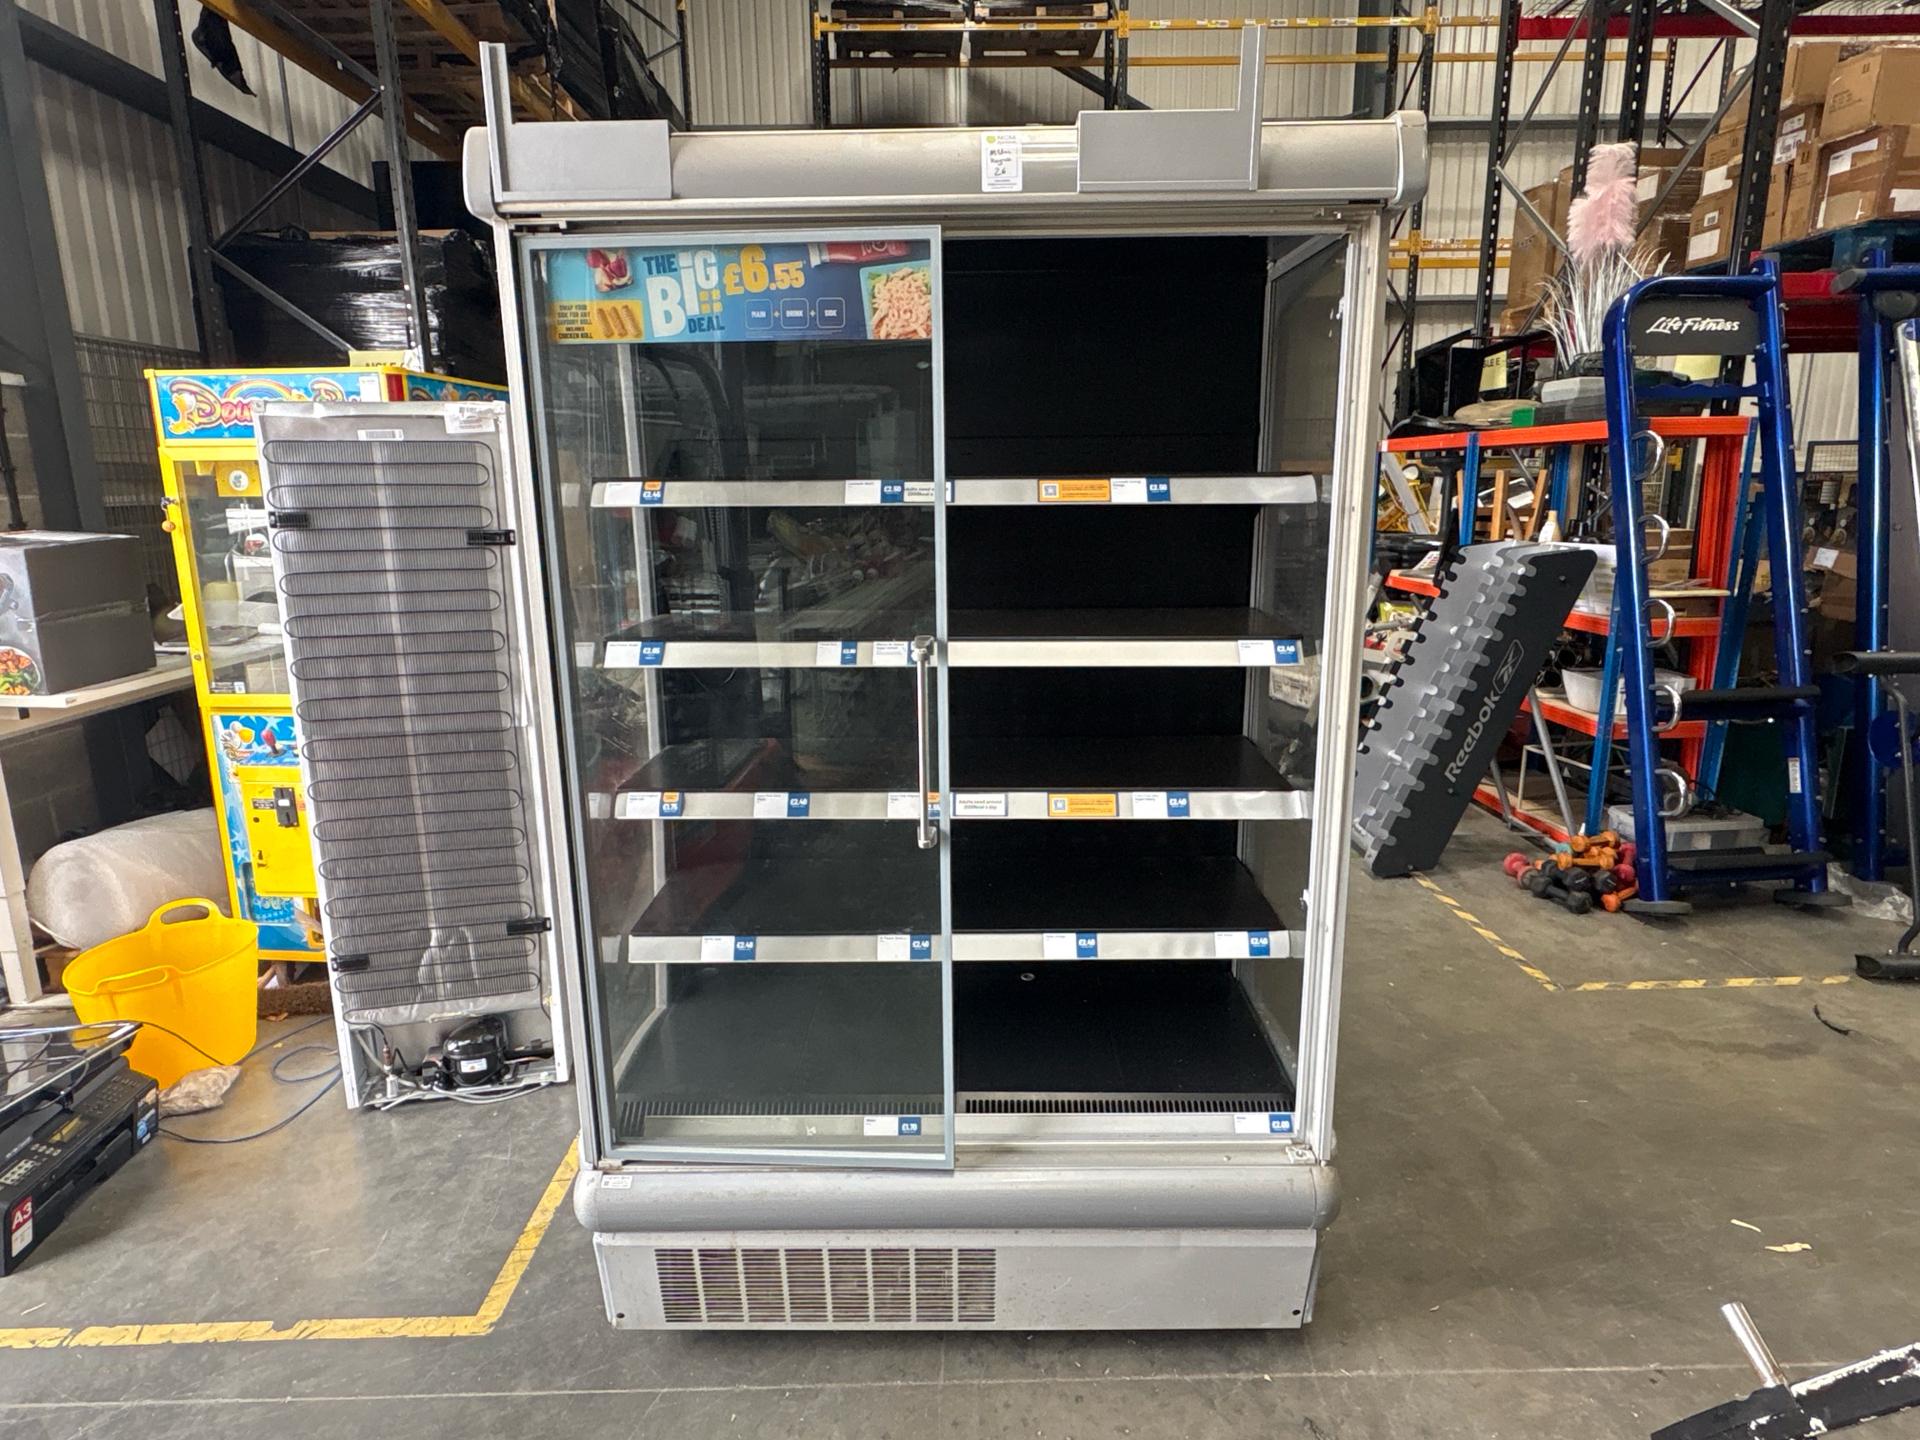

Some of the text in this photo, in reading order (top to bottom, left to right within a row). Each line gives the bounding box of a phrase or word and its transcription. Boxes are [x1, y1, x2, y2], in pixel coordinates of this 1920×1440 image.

[643, 254, 678, 275] THE
[723, 245, 806, 296] £6.55
[687, 315, 725, 334] DEAL
[1444, 688, 1502, 783] Reebok
[12, 1201, 33, 1231] A3
